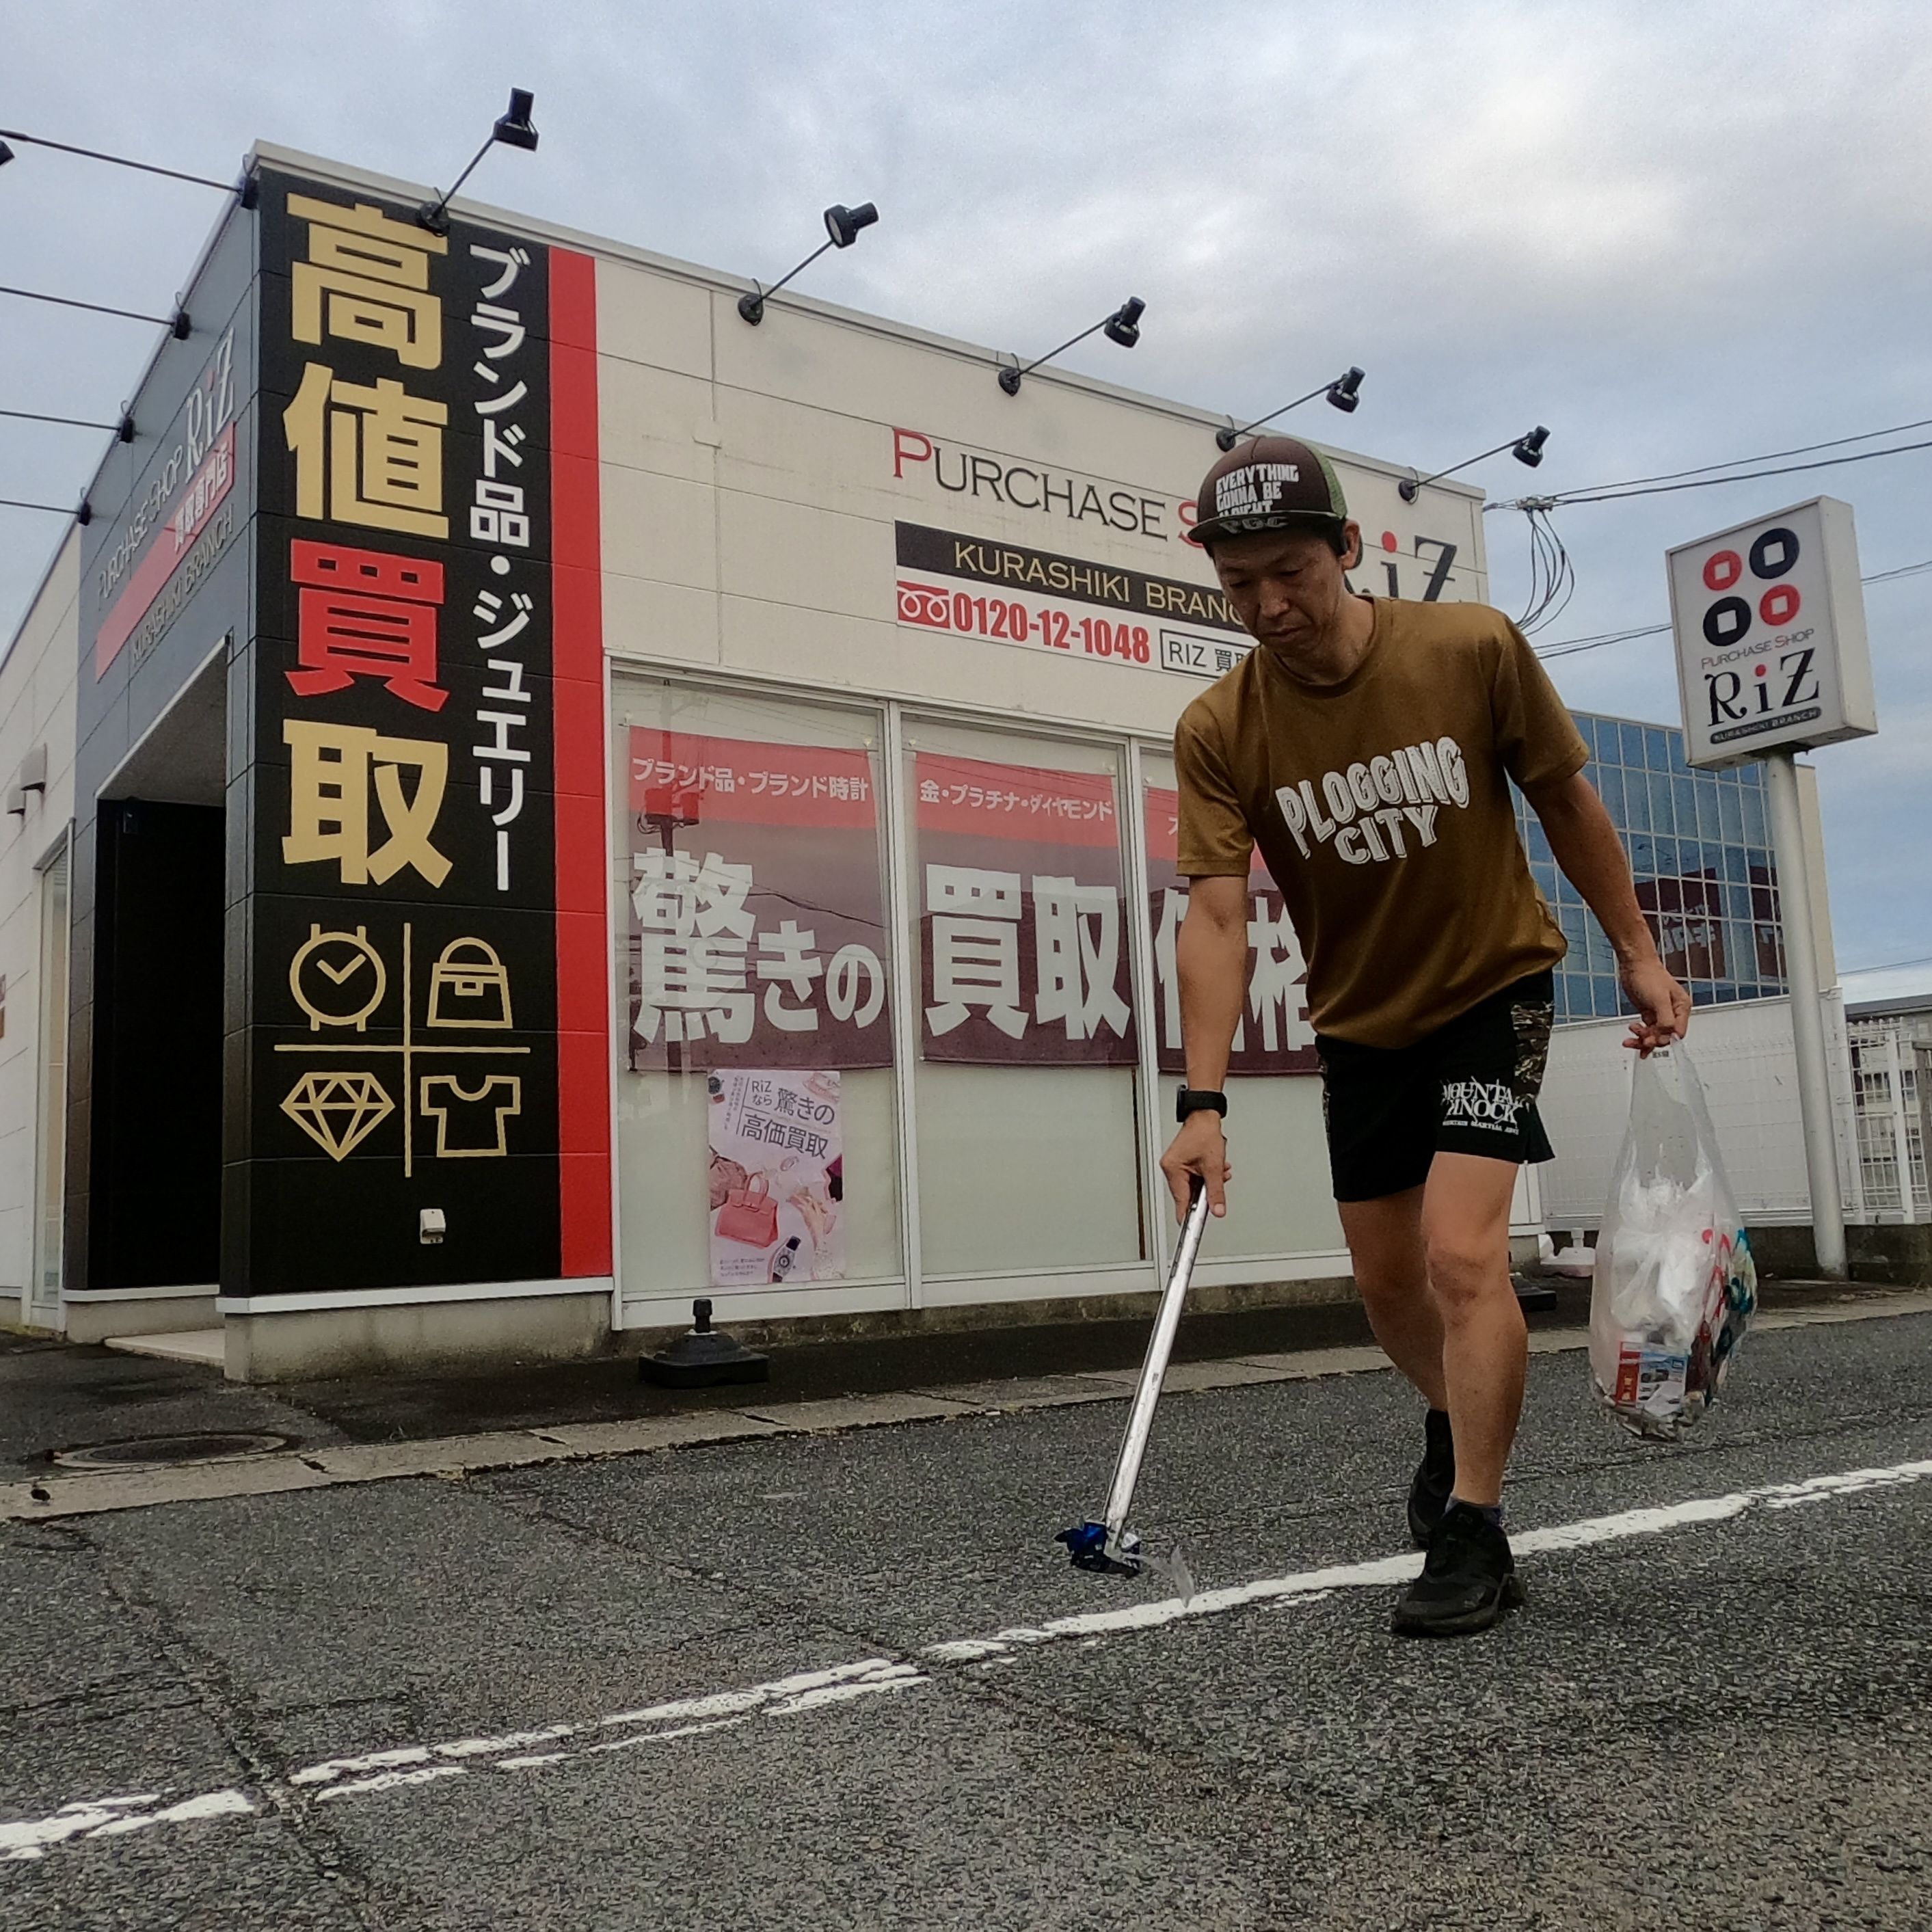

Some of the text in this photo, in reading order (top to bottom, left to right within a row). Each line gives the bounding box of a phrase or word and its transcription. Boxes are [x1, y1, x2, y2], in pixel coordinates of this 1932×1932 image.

[891, 427, 1168, 542] PURCHASE
[1216, 463, 1300, 495] EVERYTHING
[1216, 481, 1283, 512] GONNA BE
[98, 498, 149, 611] PURCHASE
[148, 444, 183, 522] SHOP
[185, 502, 234, 595] BRANCH
[282, 193, 453, 889] 高値買取
[469, 244, 533, 891] ブランド品・ジュエリー
[954, 541, 1131, 603] KURASHIKI
[952, 592, 1151, 664] 0120-12-1048
[1700, 628, 1815, 670] PURCHASE SHOP
[1168, 640, 1207, 668] RIZ
[1771, 709, 1818, 727] BRANCH
[632, 757, 870, 802] ブランド品・ブランド時計
[920, 779, 1113, 822] 金・プラチナ・ダイヤモンド
[1274, 736, 1470, 860] PLOGGING
[1334, 804, 1439, 865] CITY
[630, 847, 886, 1045] 驚きの
[924, 864, 1131, 1041] 買取
[752, 1080, 773, 1093] RiZ
[752, 1095, 773, 1106] なら
[774, 1088, 835, 1125] 驚きの
[741, 1112, 829, 1159] 高価買取
